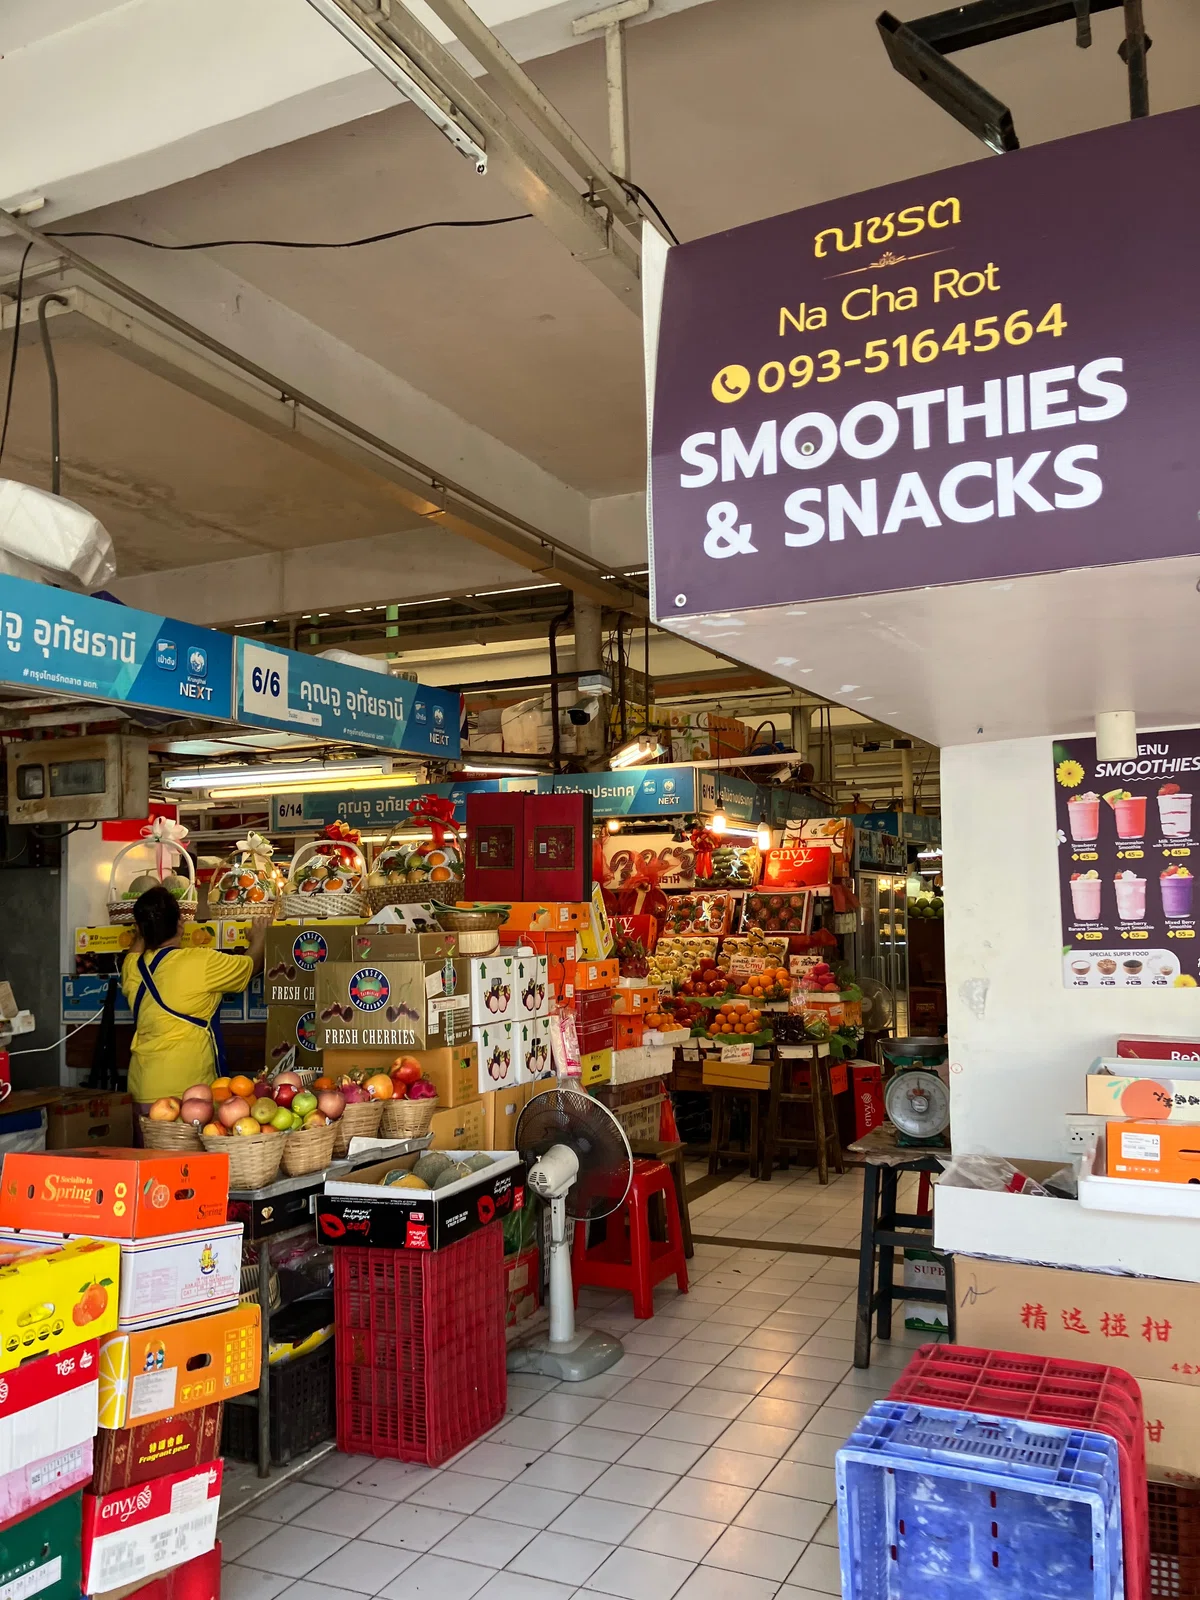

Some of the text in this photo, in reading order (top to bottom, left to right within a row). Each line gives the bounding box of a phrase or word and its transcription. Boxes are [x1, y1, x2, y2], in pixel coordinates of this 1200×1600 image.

[778, 262, 1001, 337] Na Cha Rot
[757, 302, 1068, 394] 093-5164564
[679, 357, 1129, 489] SMOOTHIES
[703, 444, 1103, 560] & SNACKS
[0, 610, 136, 664] จู อุทัยธานี
[252, 666, 281, 697] 6/6
[179, 682, 213, 701] NEXT
[301, 681, 404, 721] คุณจู อุทัยธานี
[429, 733, 450, 746] NEXT
[1137, 744, 1169, 756] ENU
[1095, 756, 1200, 778] SMOOTHIES
[658, 796, 681, 805] NEXT
[702, 784, 714, 799] 6/15
[279, 804, 302, 817] 6/14
[769, 849, 814, 867] envy
[299, 931, 322, 943] HANSEN
[355, 969, 383, 981] HANSEN
[272, 986, 301, 1000] FRESH
[355, 999, 384, 1010] ORCHARDS
[325, 1029, 415, 1045] FRESH CHERRIES
[864, 1102, 876, 1128] envy
[41, 1174, 94, 1204] Spring
[60, 1176, 86, 1184] Socialite
[197, 1203, 223, 1220] Spring
[914, 1264, 945, 1277] SUPE
[138, 1443, 191, 1464] Fragrant pear
[101, 1495, 137, 1522] envy
